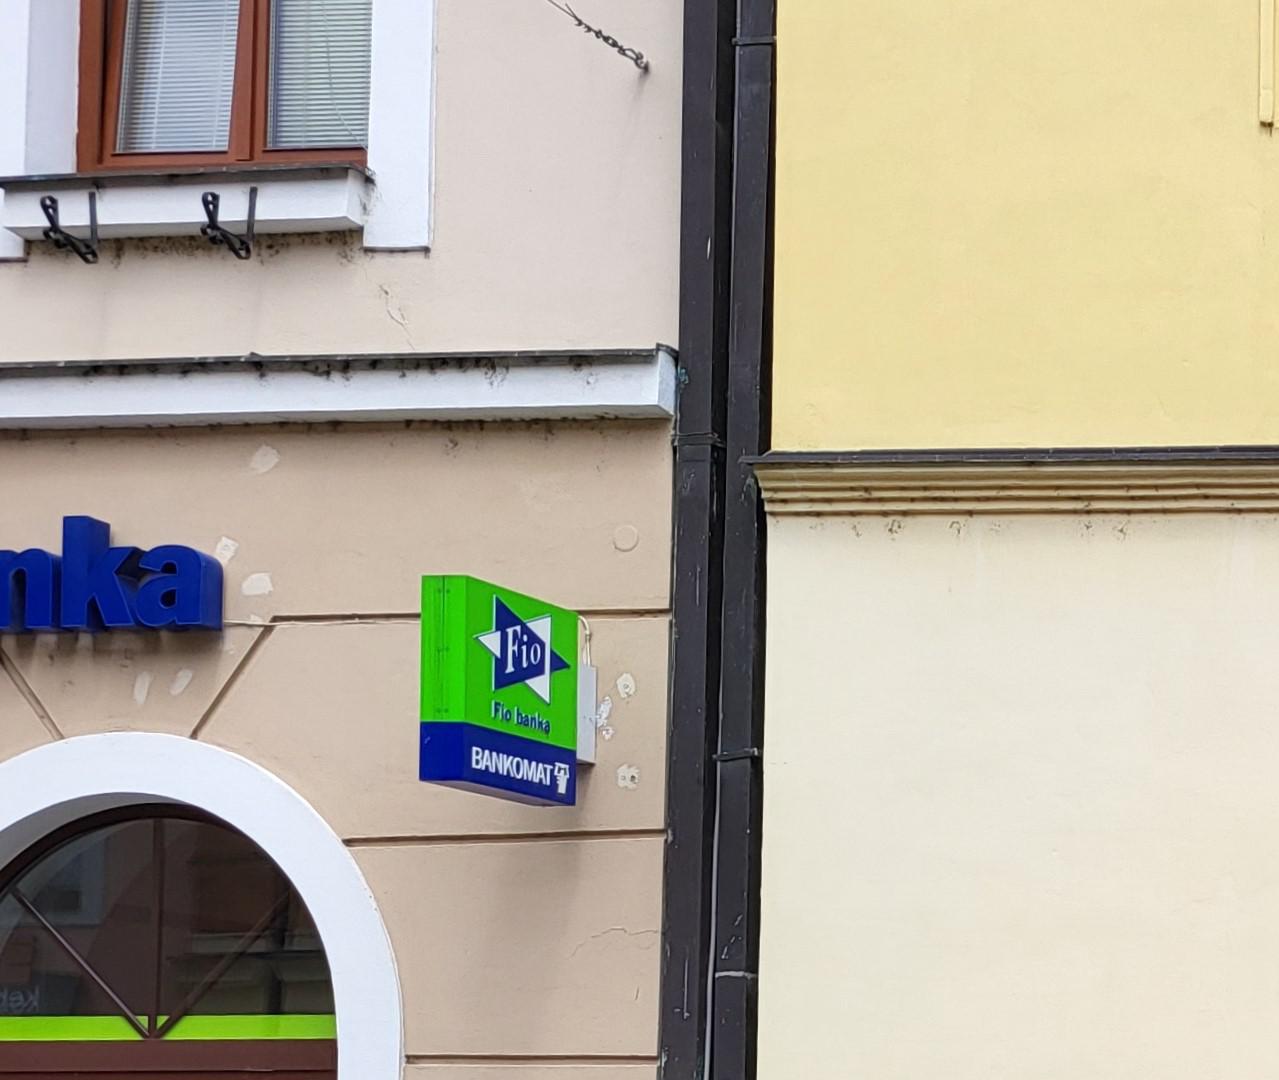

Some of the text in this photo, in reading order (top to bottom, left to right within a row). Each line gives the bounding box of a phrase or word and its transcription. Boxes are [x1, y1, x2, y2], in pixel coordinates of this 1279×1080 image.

[505, 624, 541, 674] Fio
[491, 699, 551, 735] Fio banka
[471, 746, 553, 786] BANKOMAT
